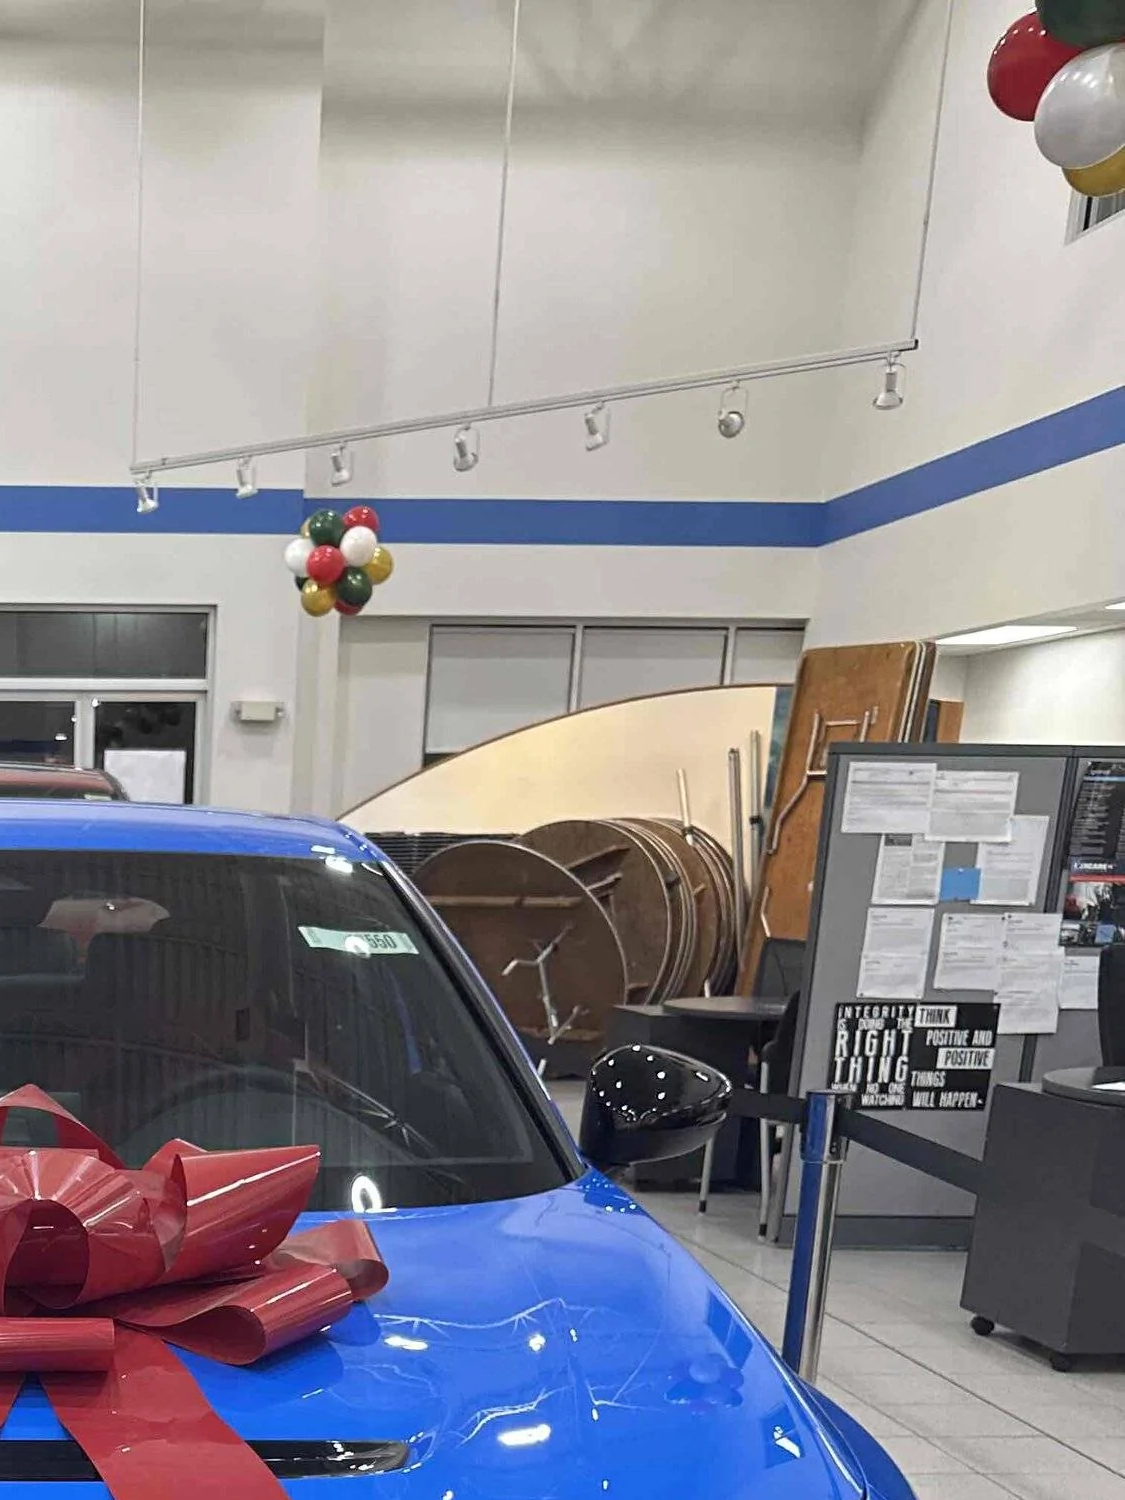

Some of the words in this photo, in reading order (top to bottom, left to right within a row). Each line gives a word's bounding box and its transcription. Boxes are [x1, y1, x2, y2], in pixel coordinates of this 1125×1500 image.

[838, 1005, 915, 1019] INTEGRITY
[920, 1008, 951, 1023] THINK
[835, 1030, 913, 1057] RIGHT
[926, 1029, 969, 1046] POSITIVE
[972, 1030, 993, 1046] AND
[944, 1050, 990, 1067] POSITIVE
[834, 1056, 909, 1084] THING
[911, 1071, 946, 1087] THINGS
[912, 1091, 935, 1107] WILL
